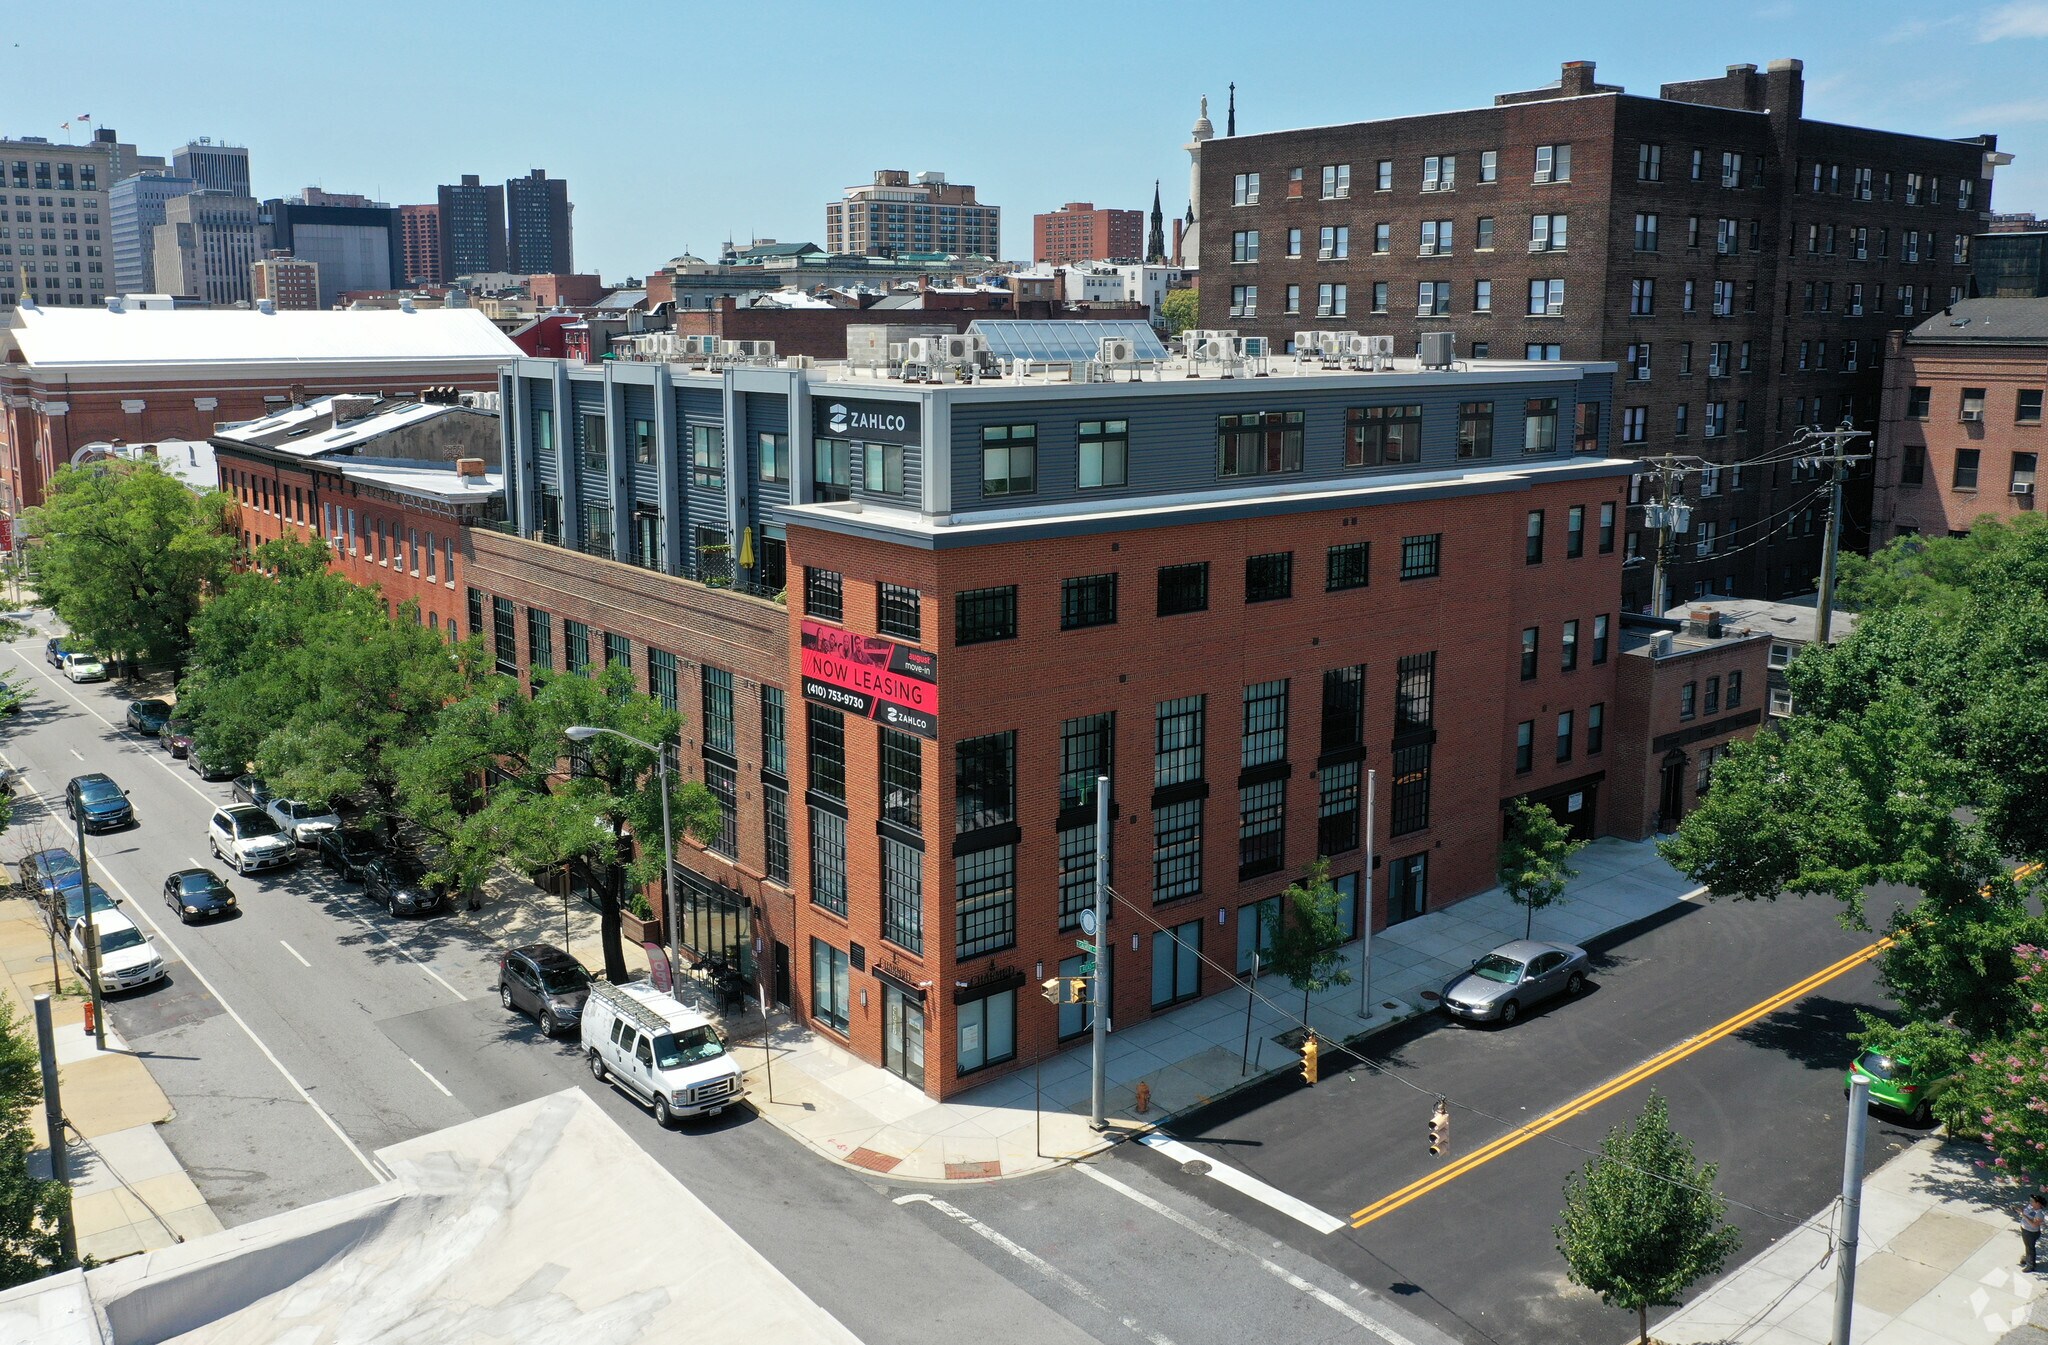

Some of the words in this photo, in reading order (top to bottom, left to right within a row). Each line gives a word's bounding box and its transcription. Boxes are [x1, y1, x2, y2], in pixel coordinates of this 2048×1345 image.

[851, 412, 906, 432] ZAHLCO
[908, 653, 931, 665] august
[904, 662, 931, 675] move-in
[812, 656, 848, 682] NOW
[854, 668, 922, 704] LEASING
[807, 683, 827, 699] (410)
[828, 690, 864, 709] 753-9730
[898, 713, 927, 729] ZAHLCO
